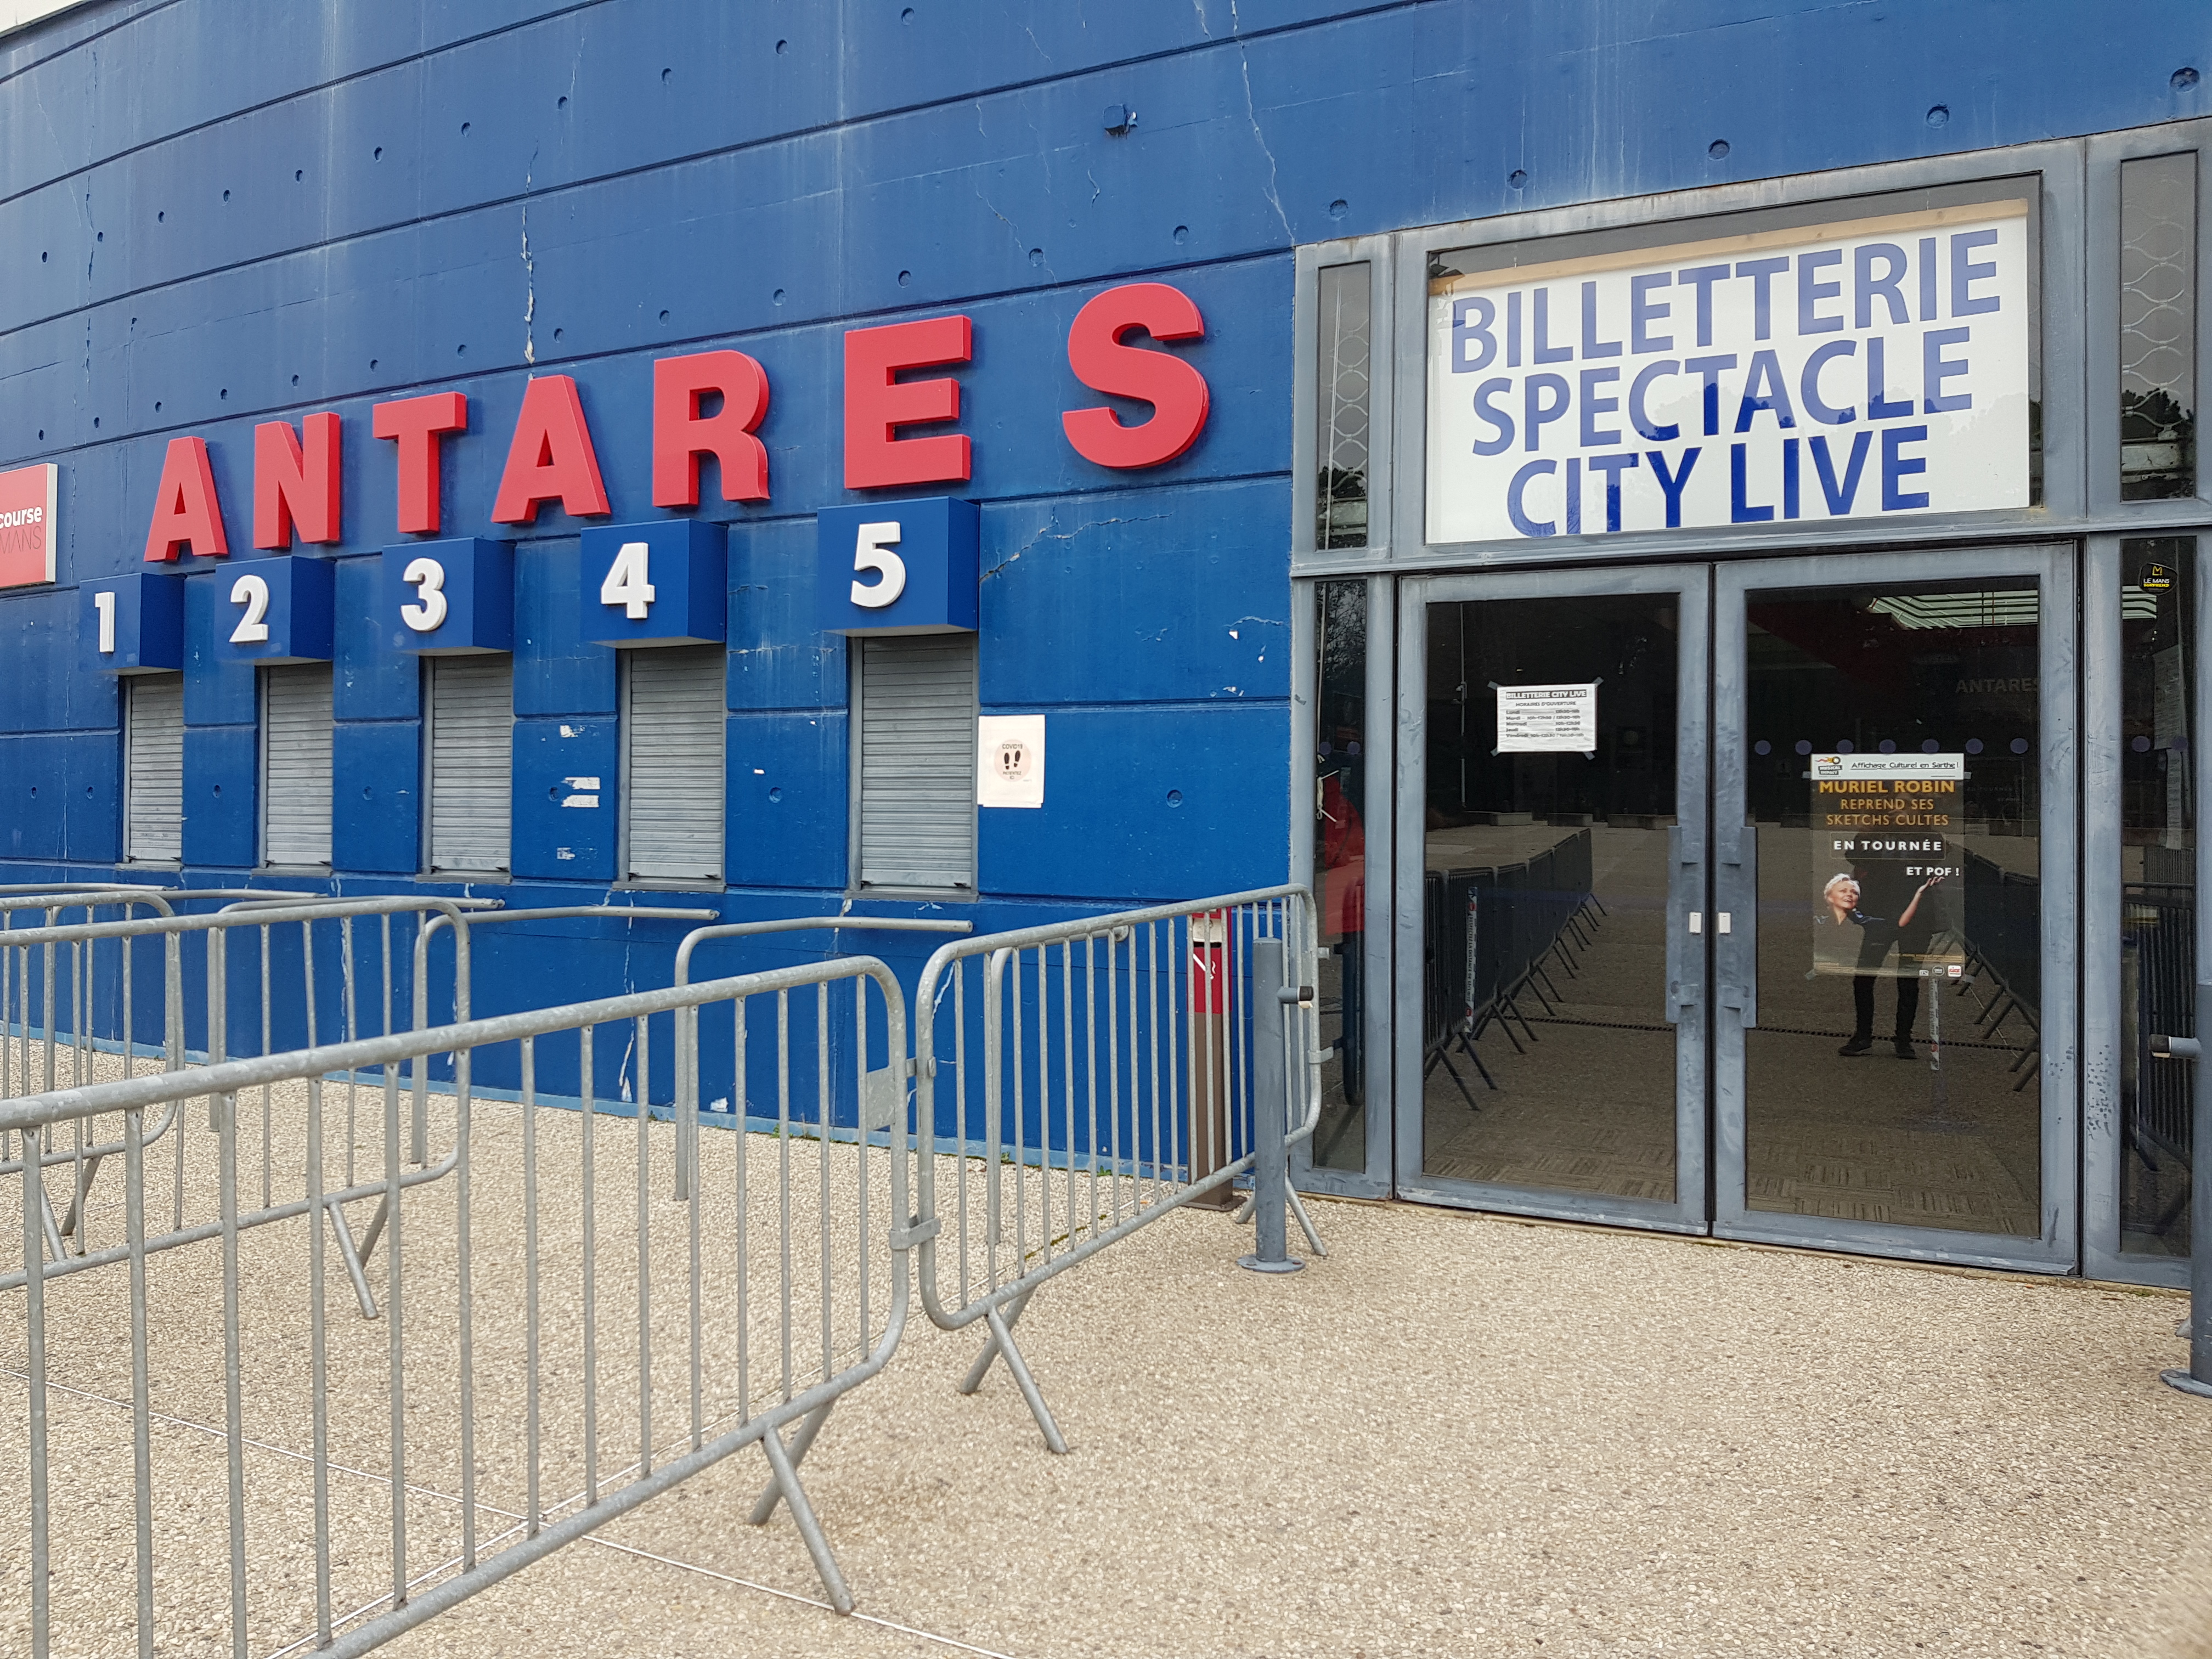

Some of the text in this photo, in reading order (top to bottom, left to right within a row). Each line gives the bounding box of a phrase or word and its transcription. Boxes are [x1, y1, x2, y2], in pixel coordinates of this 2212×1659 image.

[1451, 229, 2001, 374] BILLETTERIE
[144, 283, 1209, 562] ANTARES
[1472, 326, 1972, 456] SPECTACLE
[1507, 425, 1930, 537] CITY LIVE
[400, 557, 448, 632] 3
[601, 542, 656, 619] 4
[850, 522, 906, 608] 5
[95, 591, 115, 653] 1
[229, 574, 269, 644] 2
[1819, 780, 1955, 793] MURIEL ROBIN
[1826, 814, 1948, 826] SKETCHS CULTES
[1840, 799, 1934, 810] REPREND SES
[1834, 839, 1942, 851] EN TOURNÉE
[1906, 867, 1922, 876] ET
[1926, 867, 1952, 876] POF
